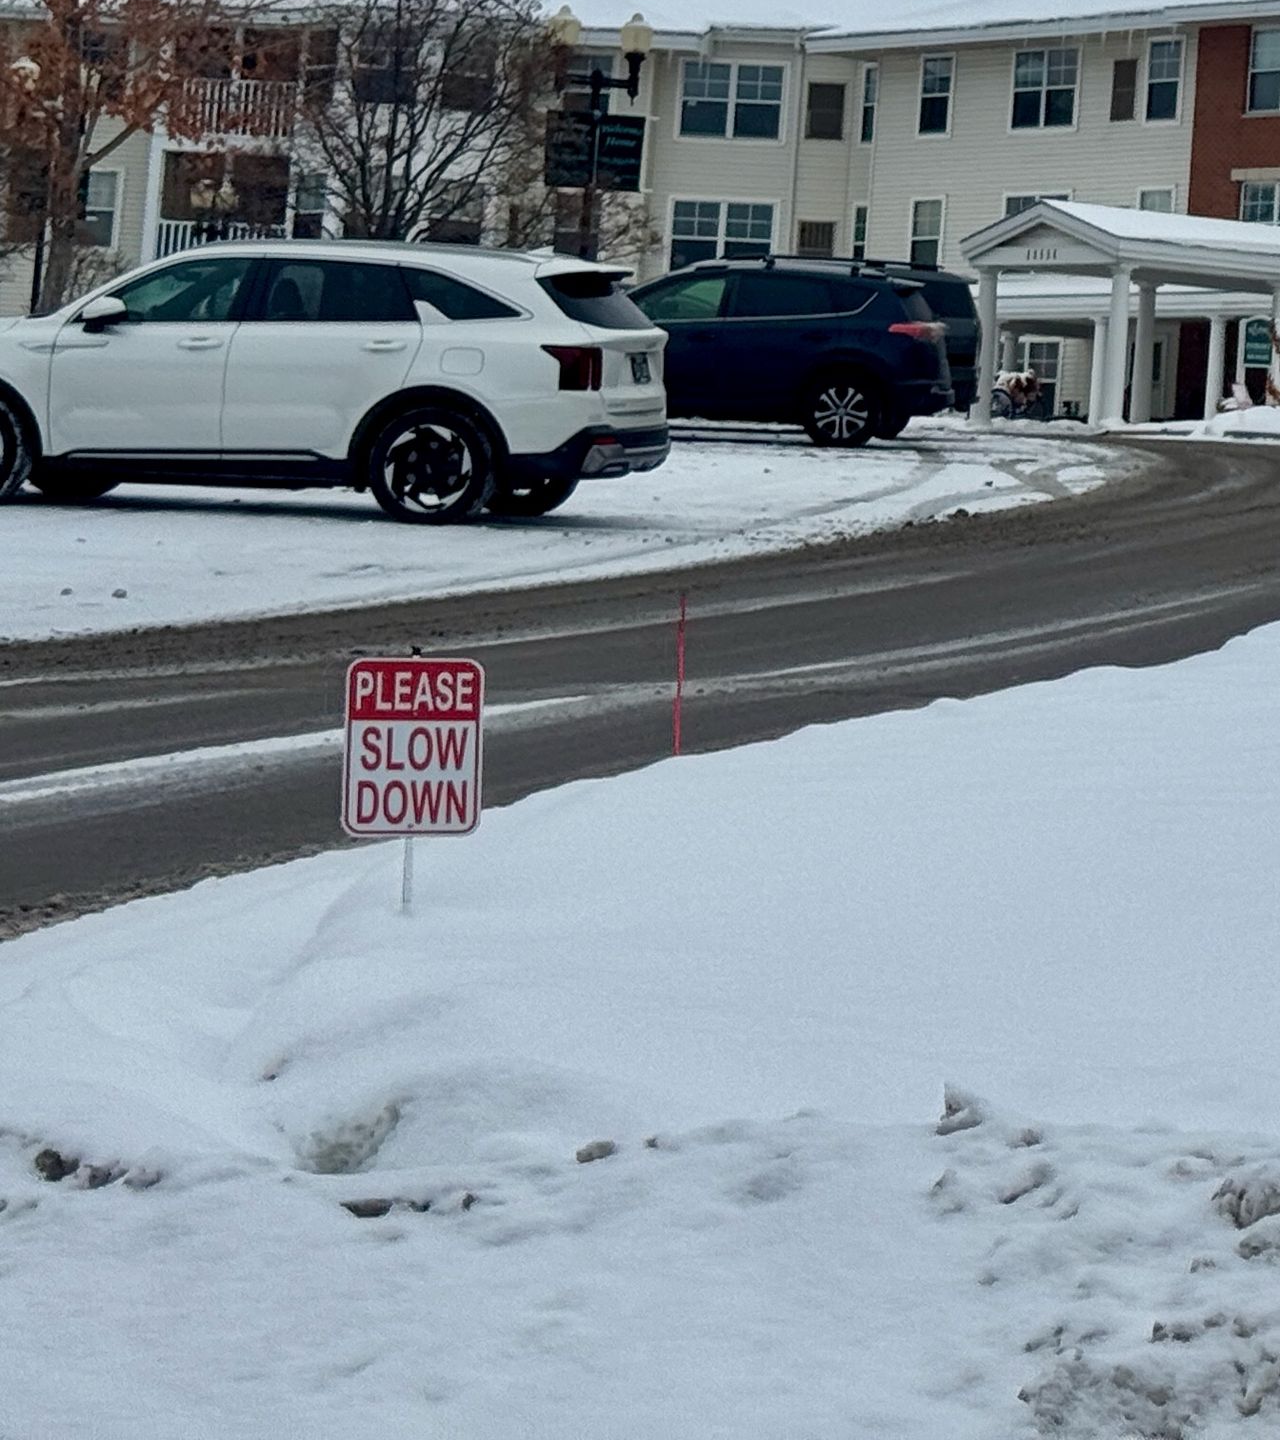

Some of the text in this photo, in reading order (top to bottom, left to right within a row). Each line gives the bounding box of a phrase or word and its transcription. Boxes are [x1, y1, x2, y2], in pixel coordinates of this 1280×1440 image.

[356, 671, 475, 712] PLEASE
[361, 726, 468, 771] SLOW
[356, 779, 468, 825] DOWN
